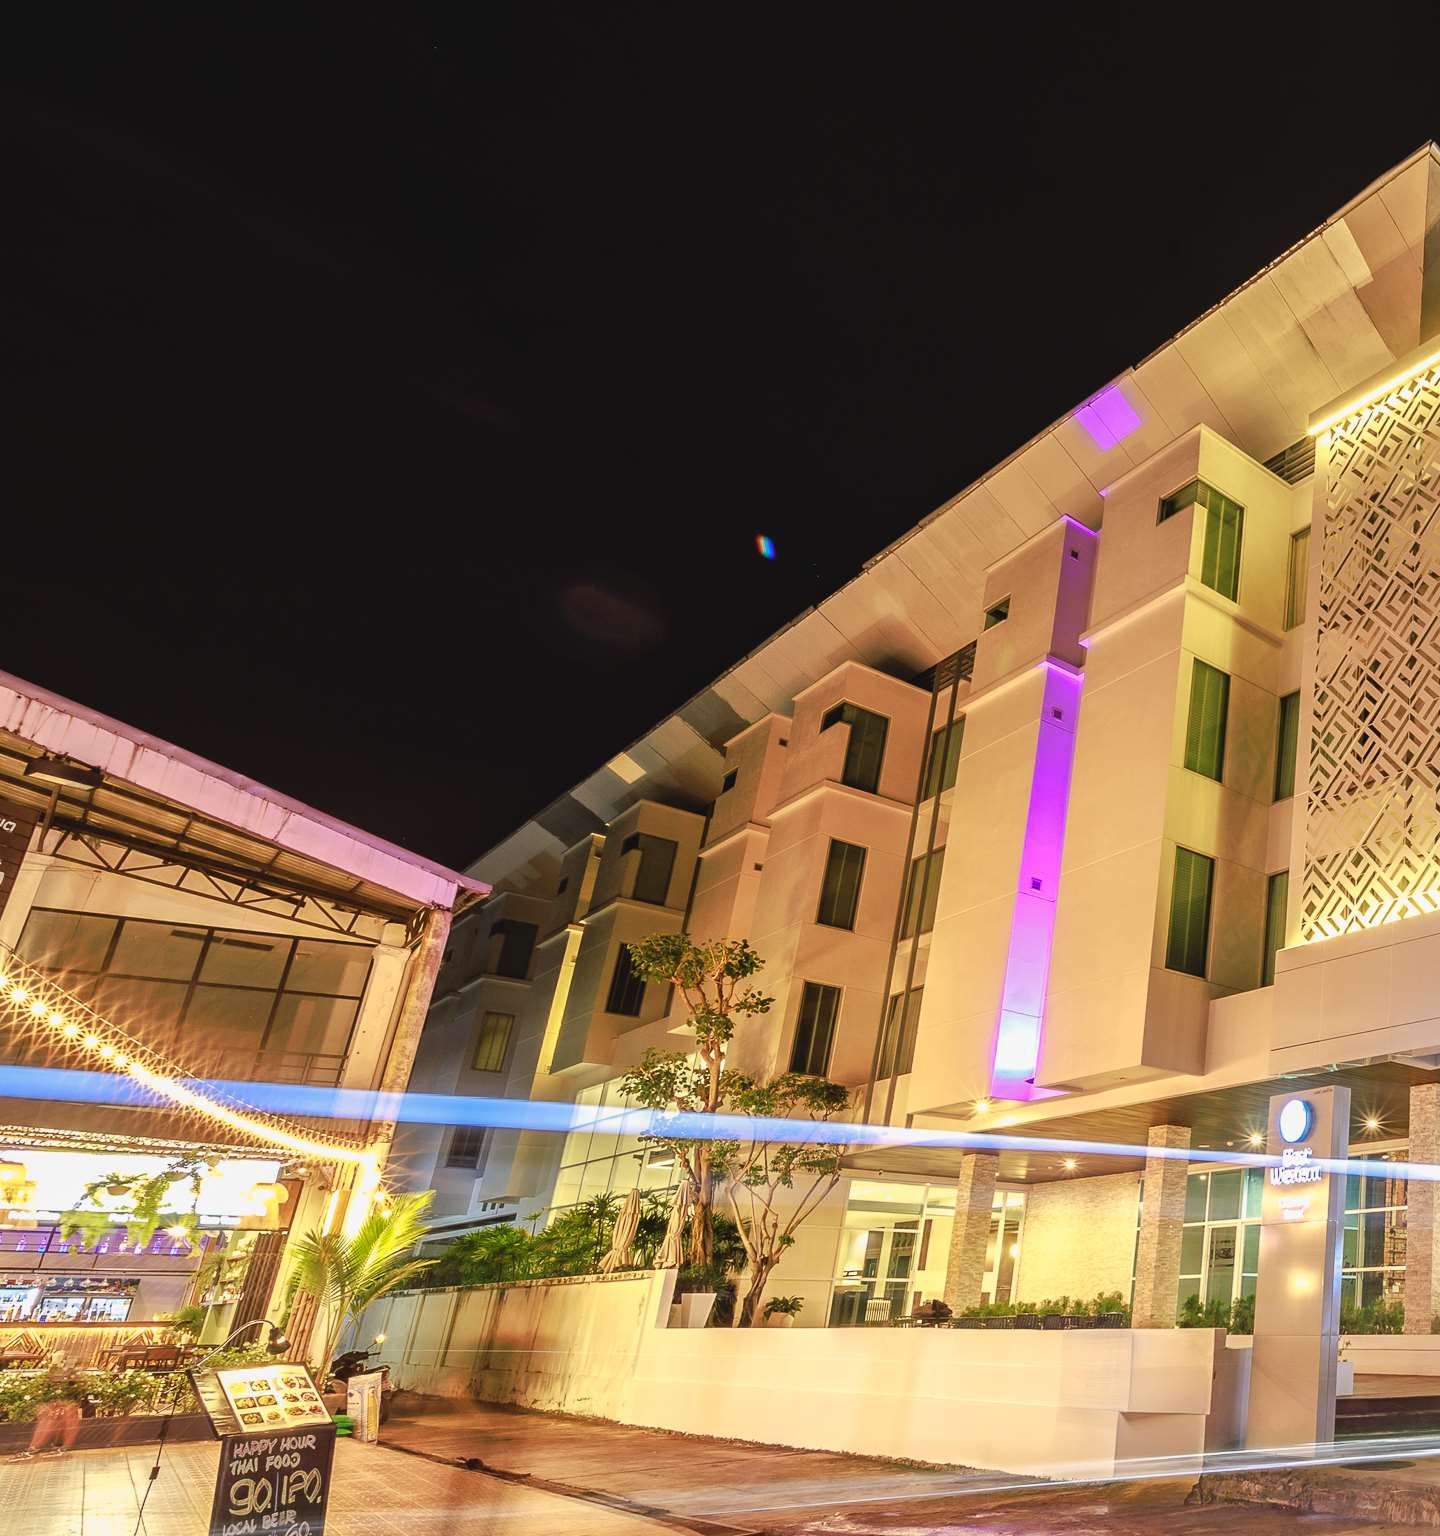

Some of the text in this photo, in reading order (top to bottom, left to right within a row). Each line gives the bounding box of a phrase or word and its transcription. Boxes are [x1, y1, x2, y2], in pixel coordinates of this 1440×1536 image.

[233, 1434, 316, 1458] HAPPY HOUR
[229, 1452, 301, 1475] THAI FOOD
[222, 1509, 297, 1536] LOCAL BEER
